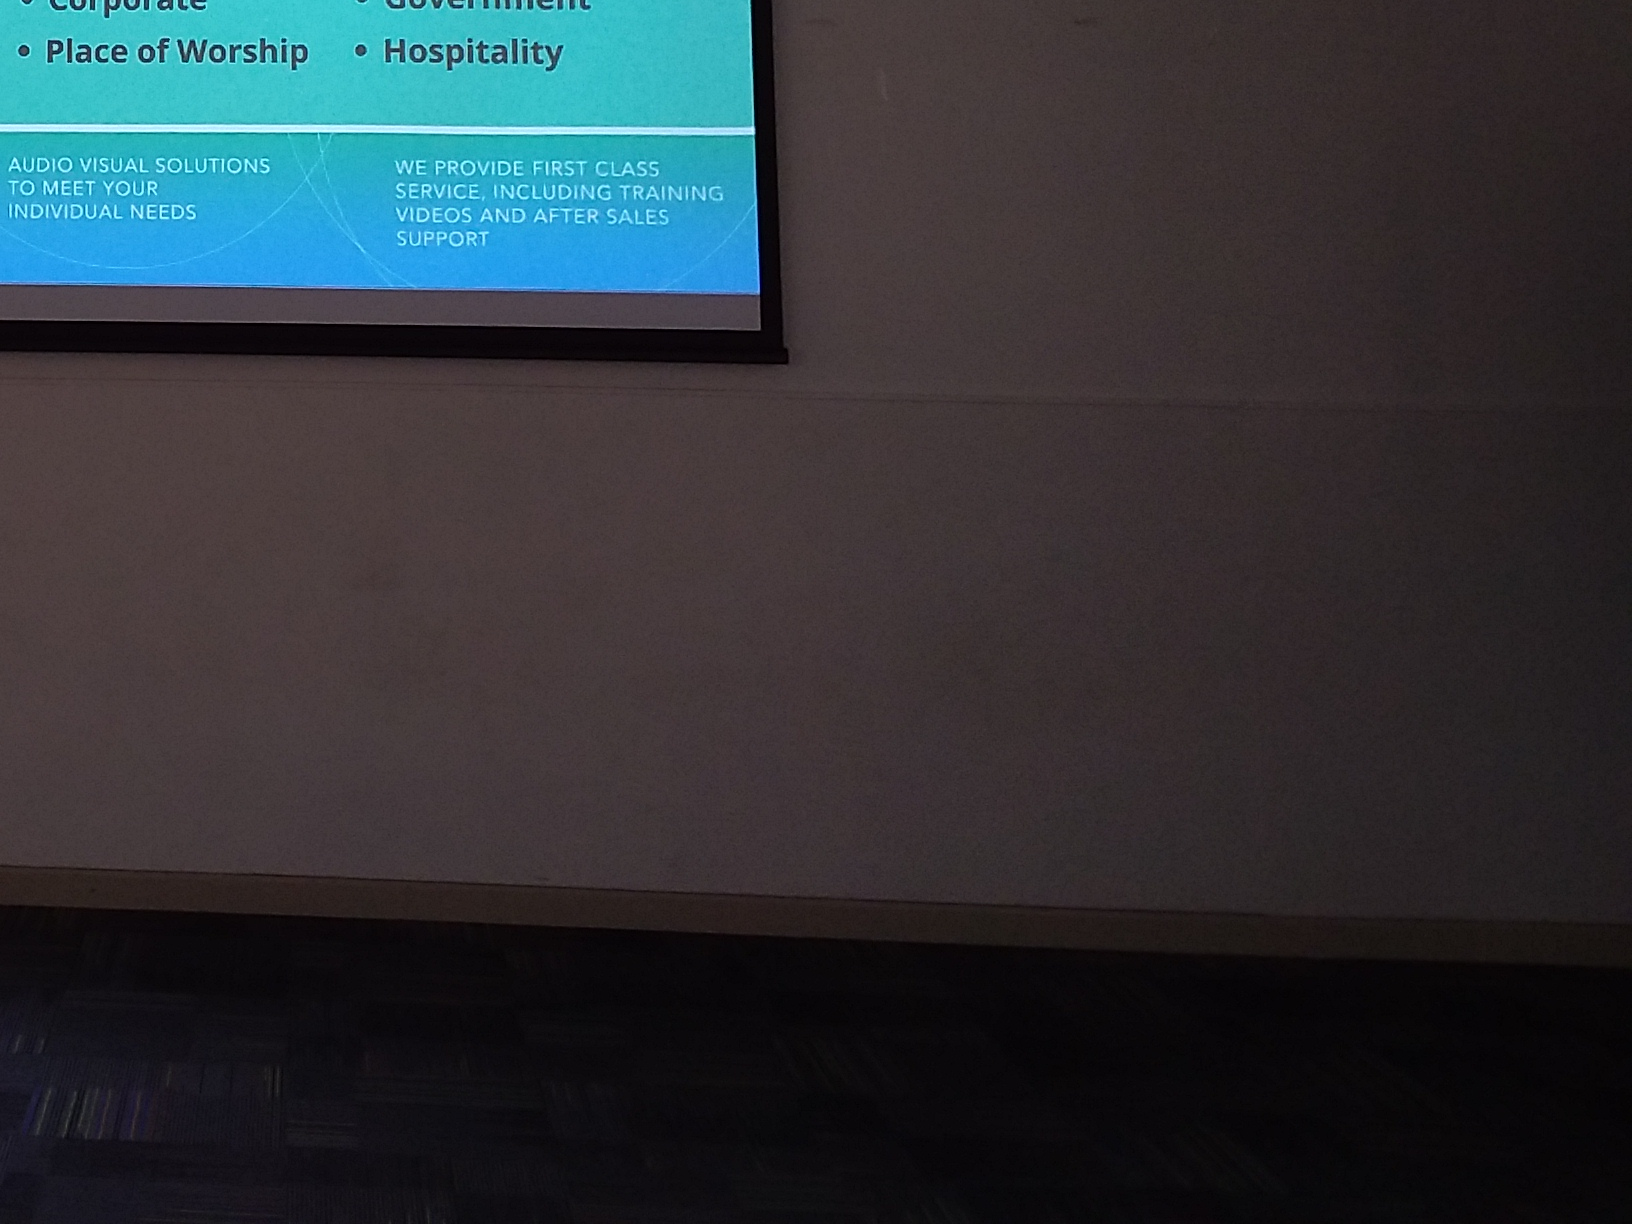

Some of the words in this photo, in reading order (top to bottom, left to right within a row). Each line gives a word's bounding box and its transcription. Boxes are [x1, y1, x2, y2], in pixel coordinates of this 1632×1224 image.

[46, 37, 129, 64] Place
[137, 37, 171, 64] of
[176, 37, 309, 71] Worship
[384, 37, 564, 72] Hospitality
[8, 156, 73, 173] AUDIO
[79, 157, 150, 174] VISUAL
[156, 157, 271, 174] SOLUTIONS
[394, 159, 427, 176] WE
[434, 159, 525, 177] PROVIDE
[533, 160, 588, 177] FIRST
[595, 160, 660, 178] CLASS
[7, 179, 35, 196] TO
[42, 180, 97, 197] MEET
[102, 180, 158, 197] YOUR
[395, 182, 486, 204] SERVICE,
[493, 183, 612, 201] INCLUDING
[618, 184, 724, 202] TRAINING
[8, 202, 124, 220] INDIVIDUAL
[130, 203, 197, 221] NEEDS
[395, 206, 473, 224] VIDEOS
[479, 207, 527, 224] AND
[533, 207, 599, 225] AFTER
[606, 208, 669, 226] SALES
[396, 230, 490, 248] SUPPORT
